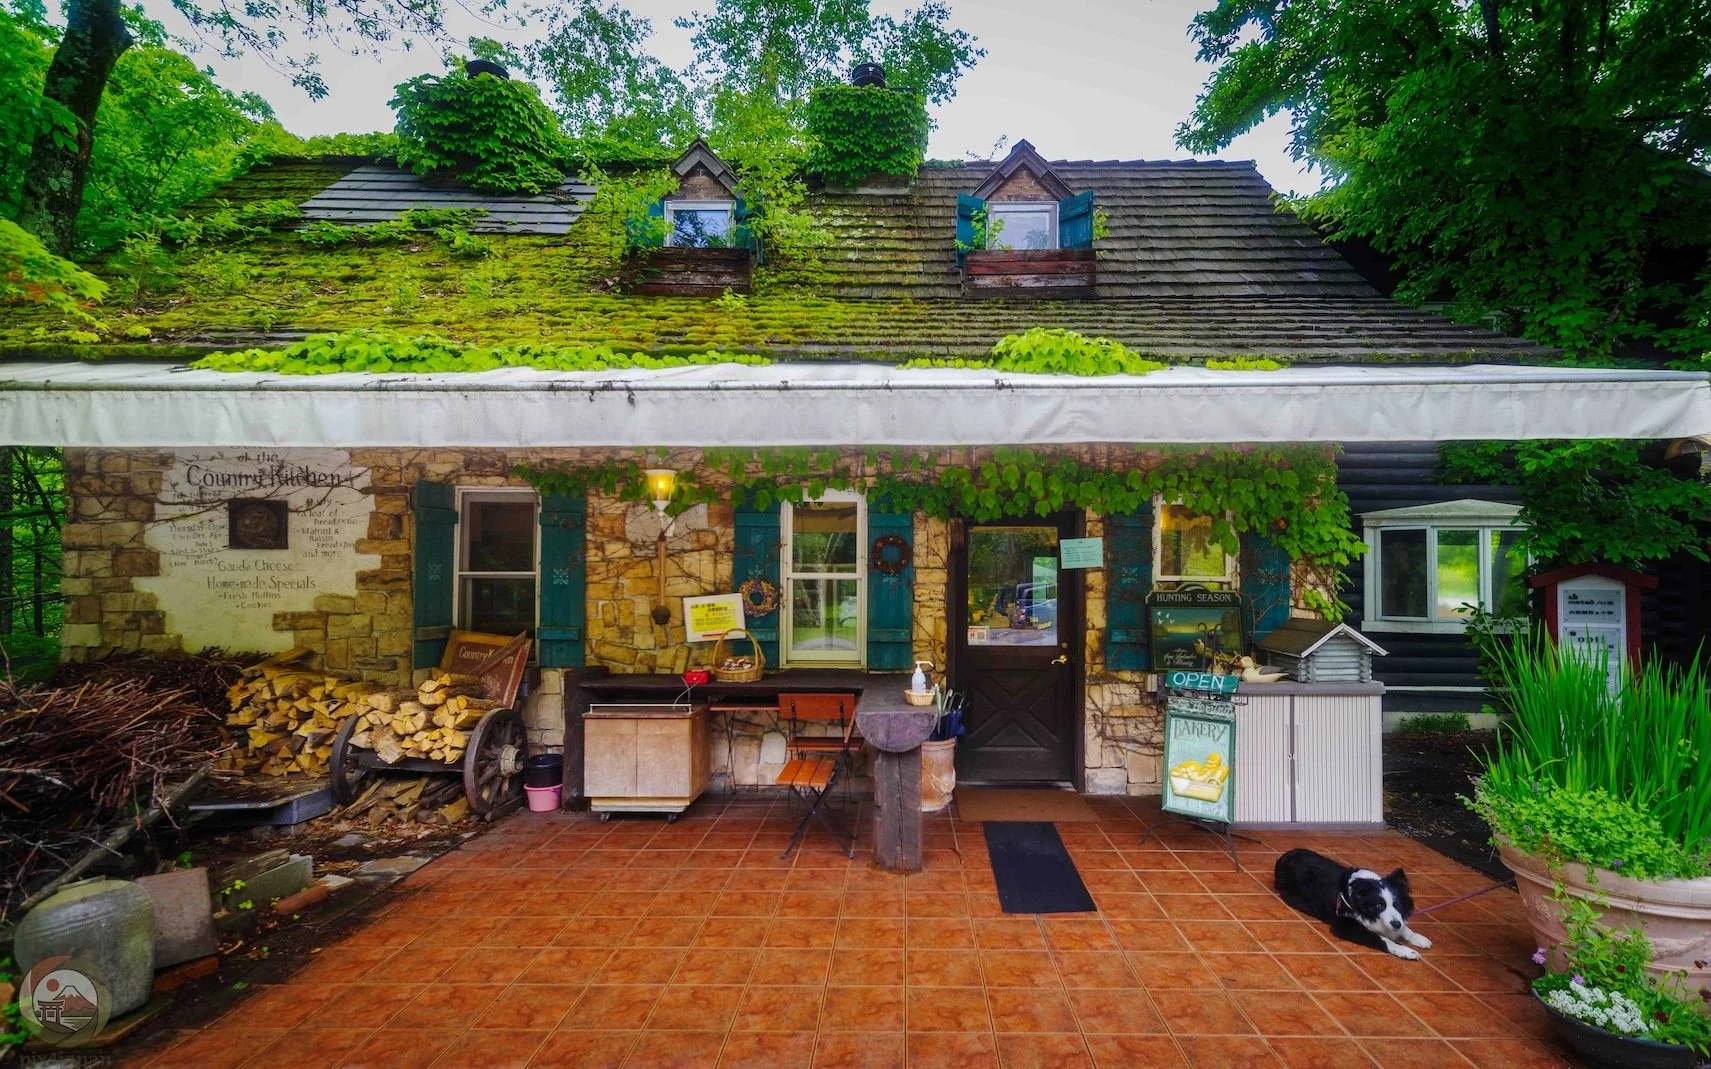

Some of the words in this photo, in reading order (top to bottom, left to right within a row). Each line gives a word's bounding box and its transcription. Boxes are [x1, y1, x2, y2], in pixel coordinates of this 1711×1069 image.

[257, 451, 279, 463] the
[187, 464, 263, 488] Country
[269, 464, 342, 488] Kitchen
[254, 559, 295, 572] Cheese
[268, 575, 316, 591] Specials
[1156, 592, 1192, 603] HUNTING
[1197, 592, 1232, 603] SEASON
[458, 646, 488, 662] Country
[1172, 672, 1225, 691] OPEN
[1174, 719, 1226, 742] BAKERY
